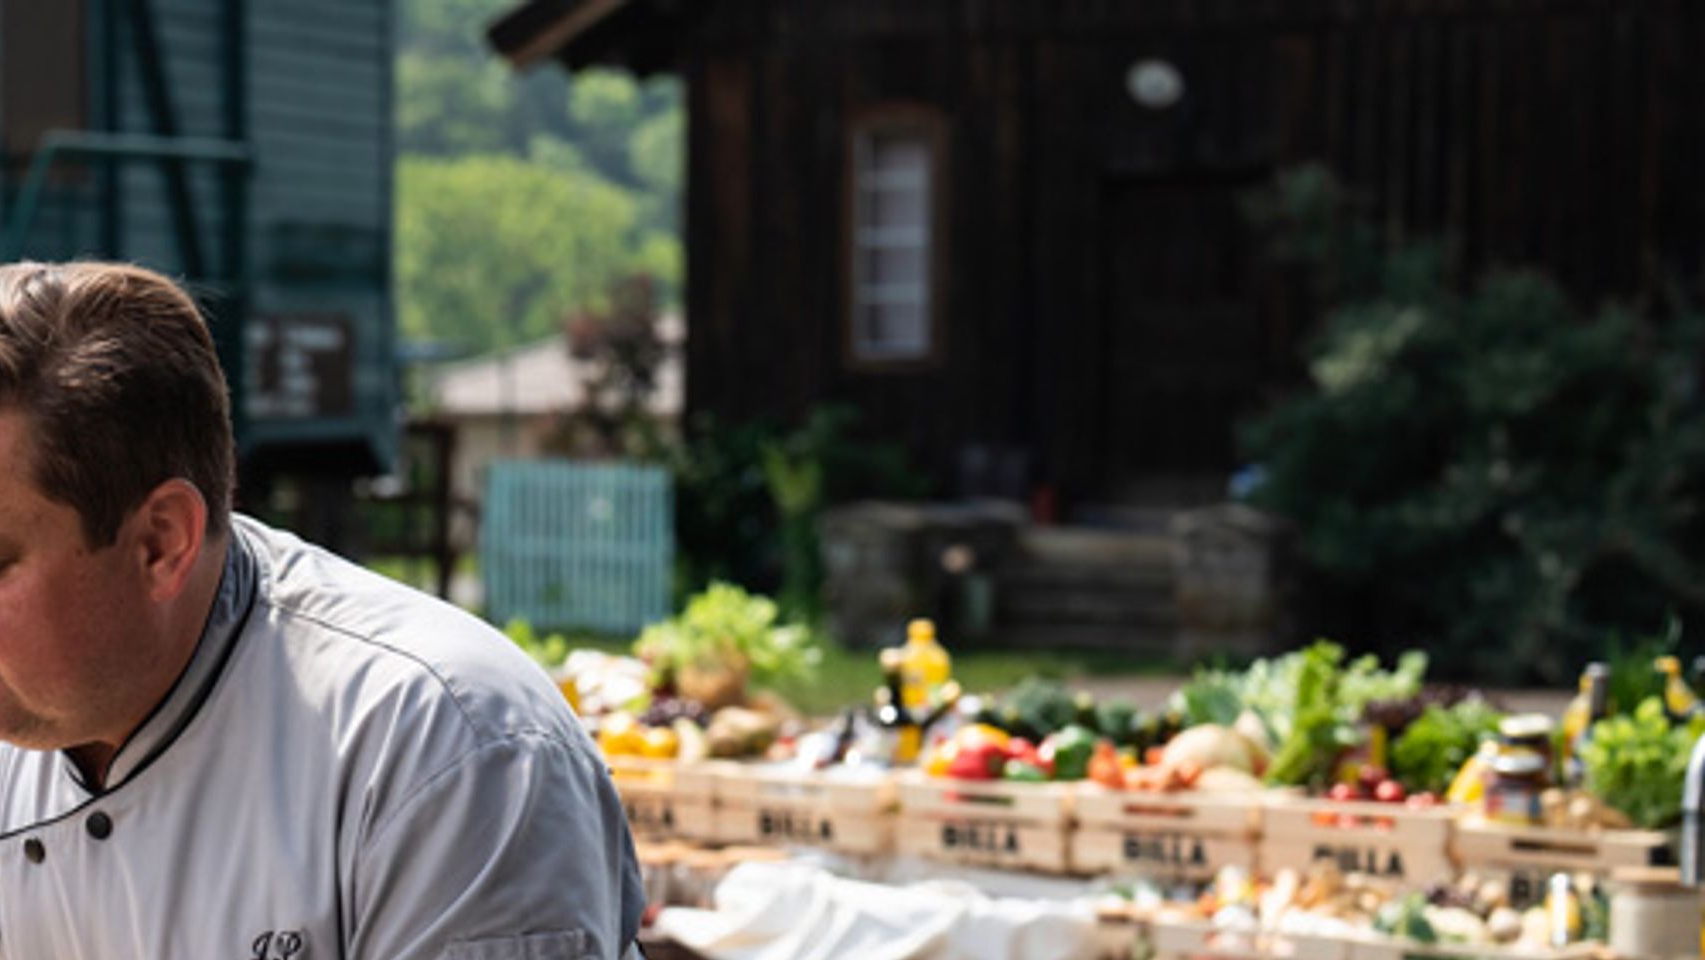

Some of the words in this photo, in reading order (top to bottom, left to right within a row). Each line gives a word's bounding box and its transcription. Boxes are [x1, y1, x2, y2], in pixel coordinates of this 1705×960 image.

[758, 808, 835, 840] BILLA
[941, 822, 1020, 852] BILLA
[1123, 832, 1207, 865] BILLA
